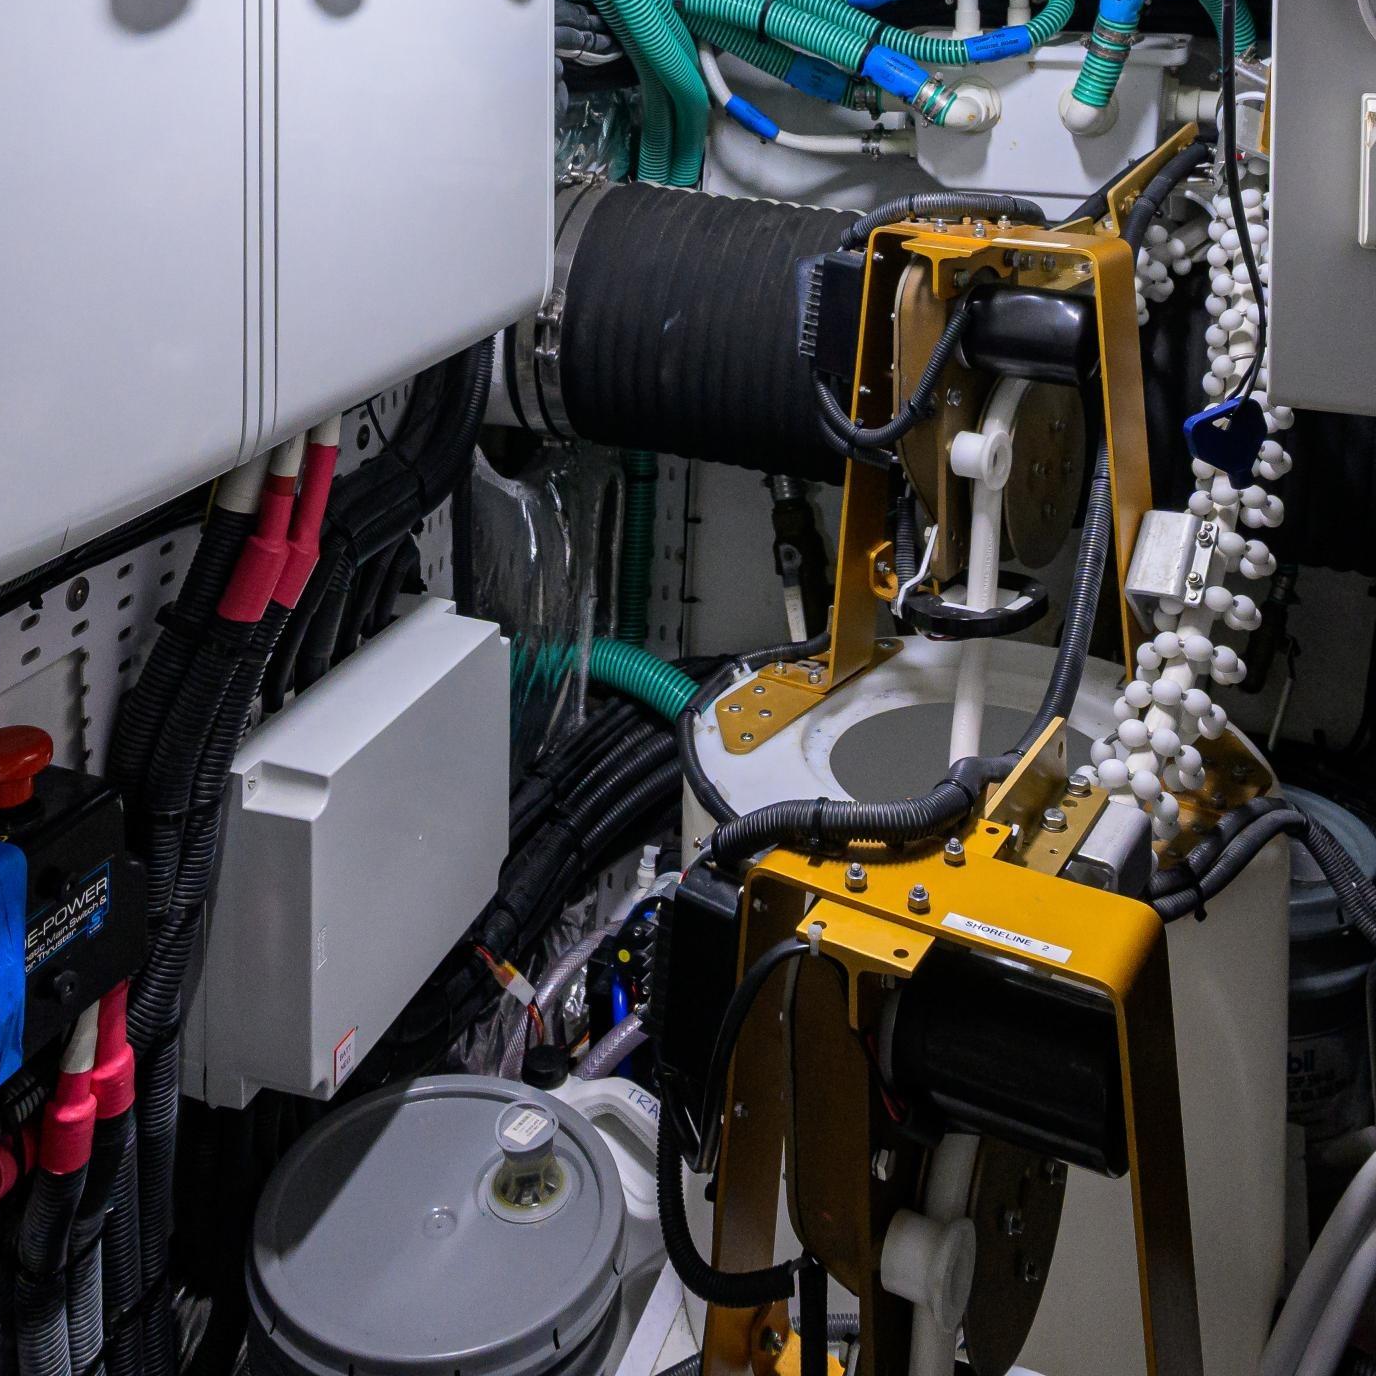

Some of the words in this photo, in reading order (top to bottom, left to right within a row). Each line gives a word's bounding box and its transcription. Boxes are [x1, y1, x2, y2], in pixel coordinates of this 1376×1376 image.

[24, 876, 108, 951] E-POWER
[46, 925, 69, 946] Main
[69, 901, 99, 929] Switch
[36, 927, 77, 962] Thruster
[964, 920, 1033, 947] SHORELINE
[1041, 944, 1050, 952] 2
